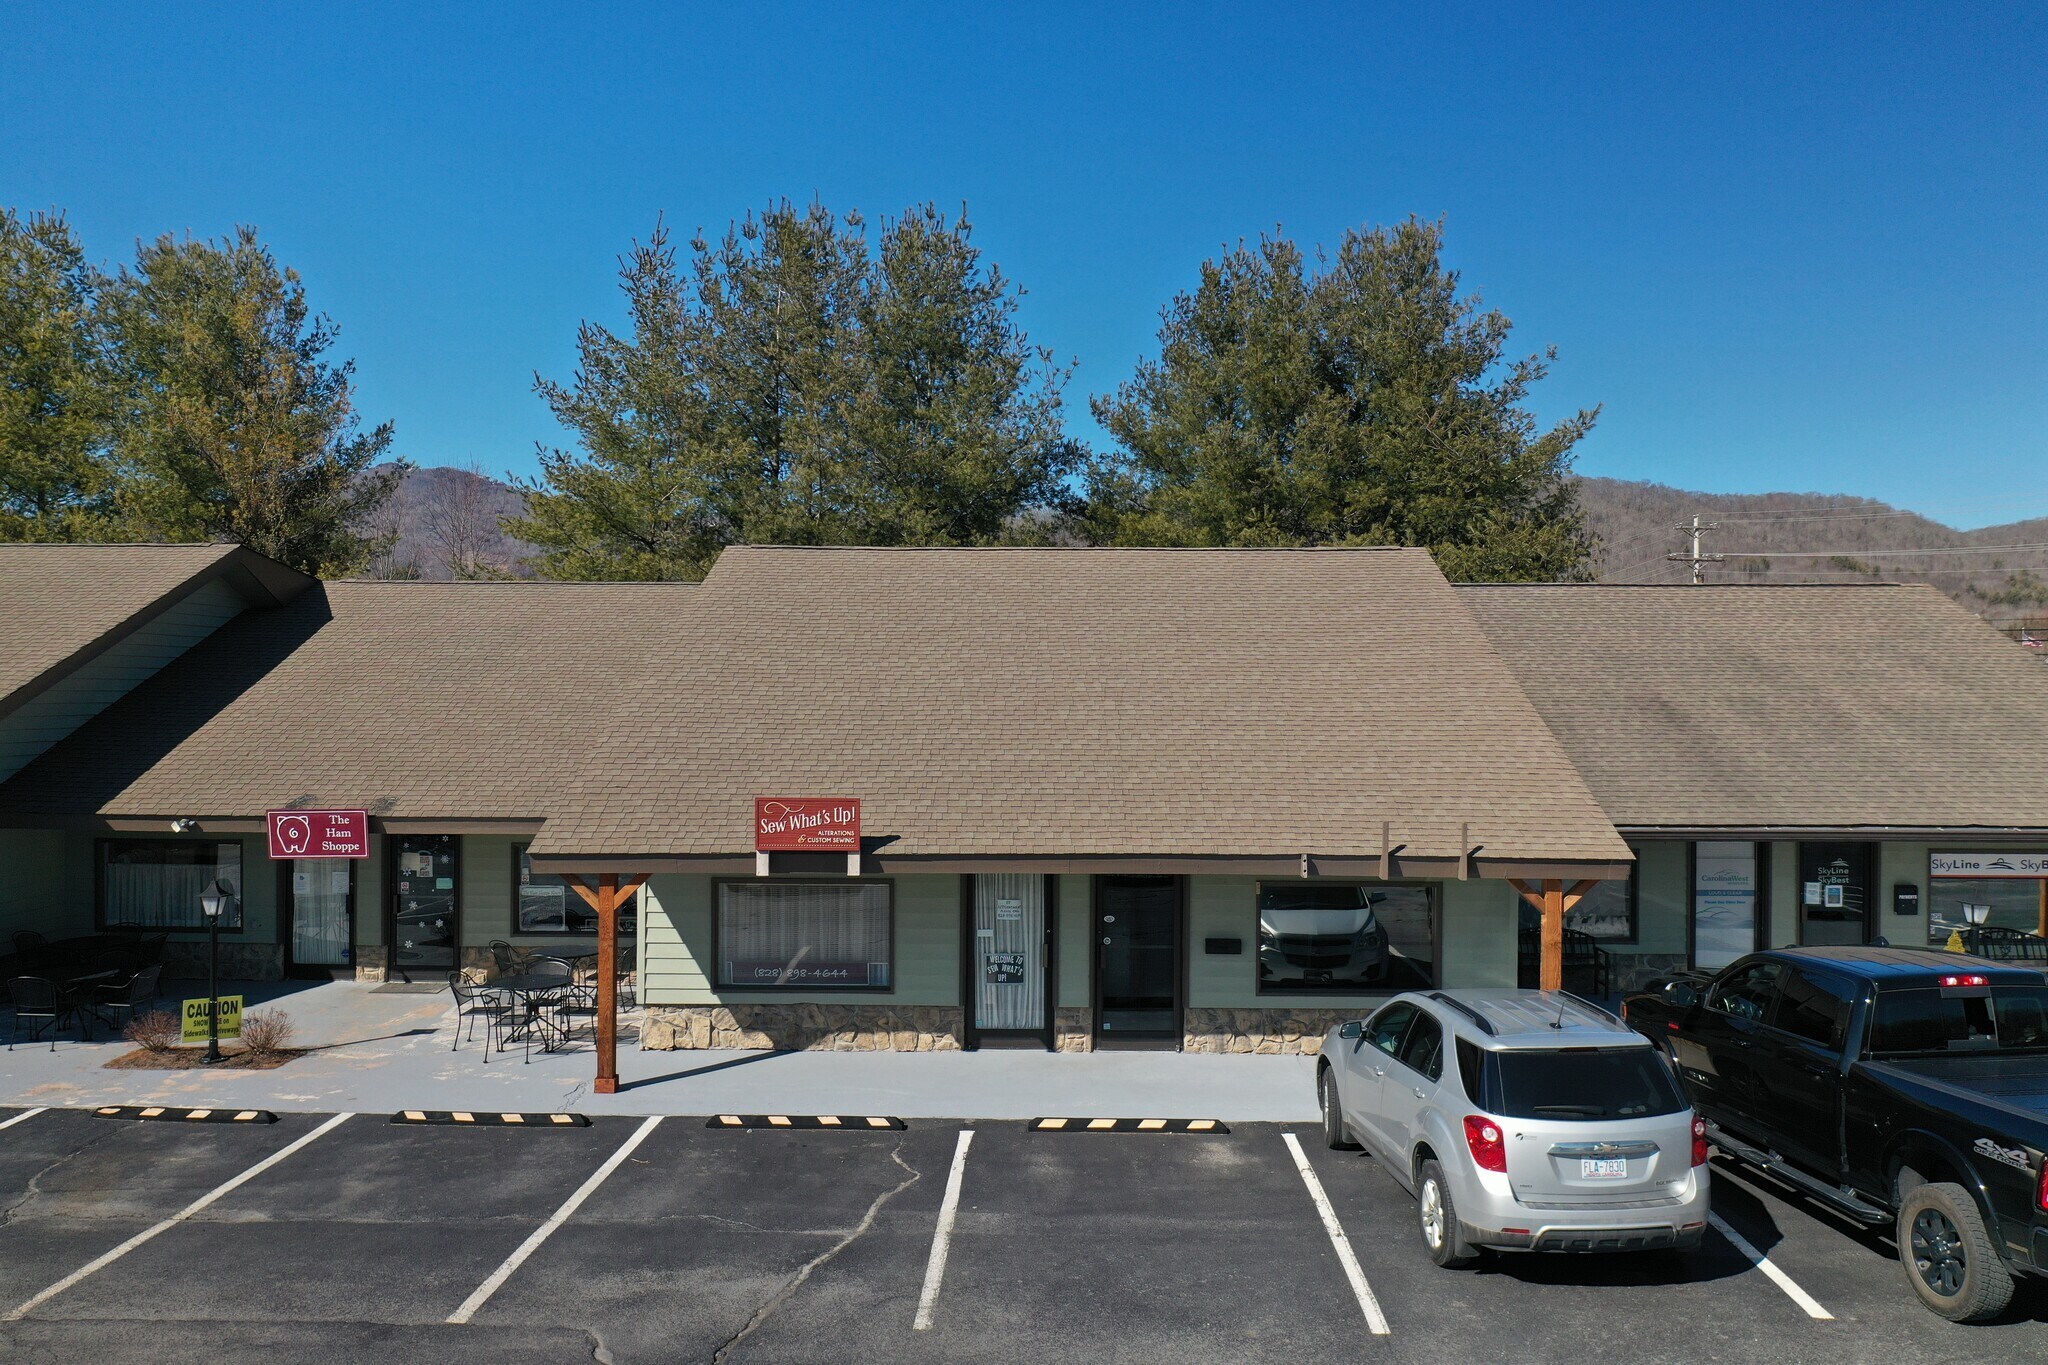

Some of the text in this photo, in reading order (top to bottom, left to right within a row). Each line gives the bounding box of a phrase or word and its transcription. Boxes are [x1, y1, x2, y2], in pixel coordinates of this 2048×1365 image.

[329, 815, 350, 824] The
[760, 806, 855, 834] Sew What's Up!
[326, 828, 352, 837] Ham
[797, 834, 807, 844] &
[322, 841, 360, 853] Shoppe
[1931, 858, 1980, 872] SkyLine
[1817, 867, 1849, 876] SkyLine
[1701, 874, 1749, 882] CarolinaWest
[1817, 876, 1850, 885] SkyBest
[990, 955, 1023, 965] WELCOME TO
[754, 967, 848, 980] (828) 898-4644
[987, 963, 1023, 976] SEW WHAT'S
[997, 973, 1007, 982] UP!
[188, 1000, 238, 1018] CAUION
[1974, 1137, 2030, 1166] 4x4
[1584, 1160, 1625, 1173] FLA-7830
[1996, 1154, 2027, 1170] ROAD
